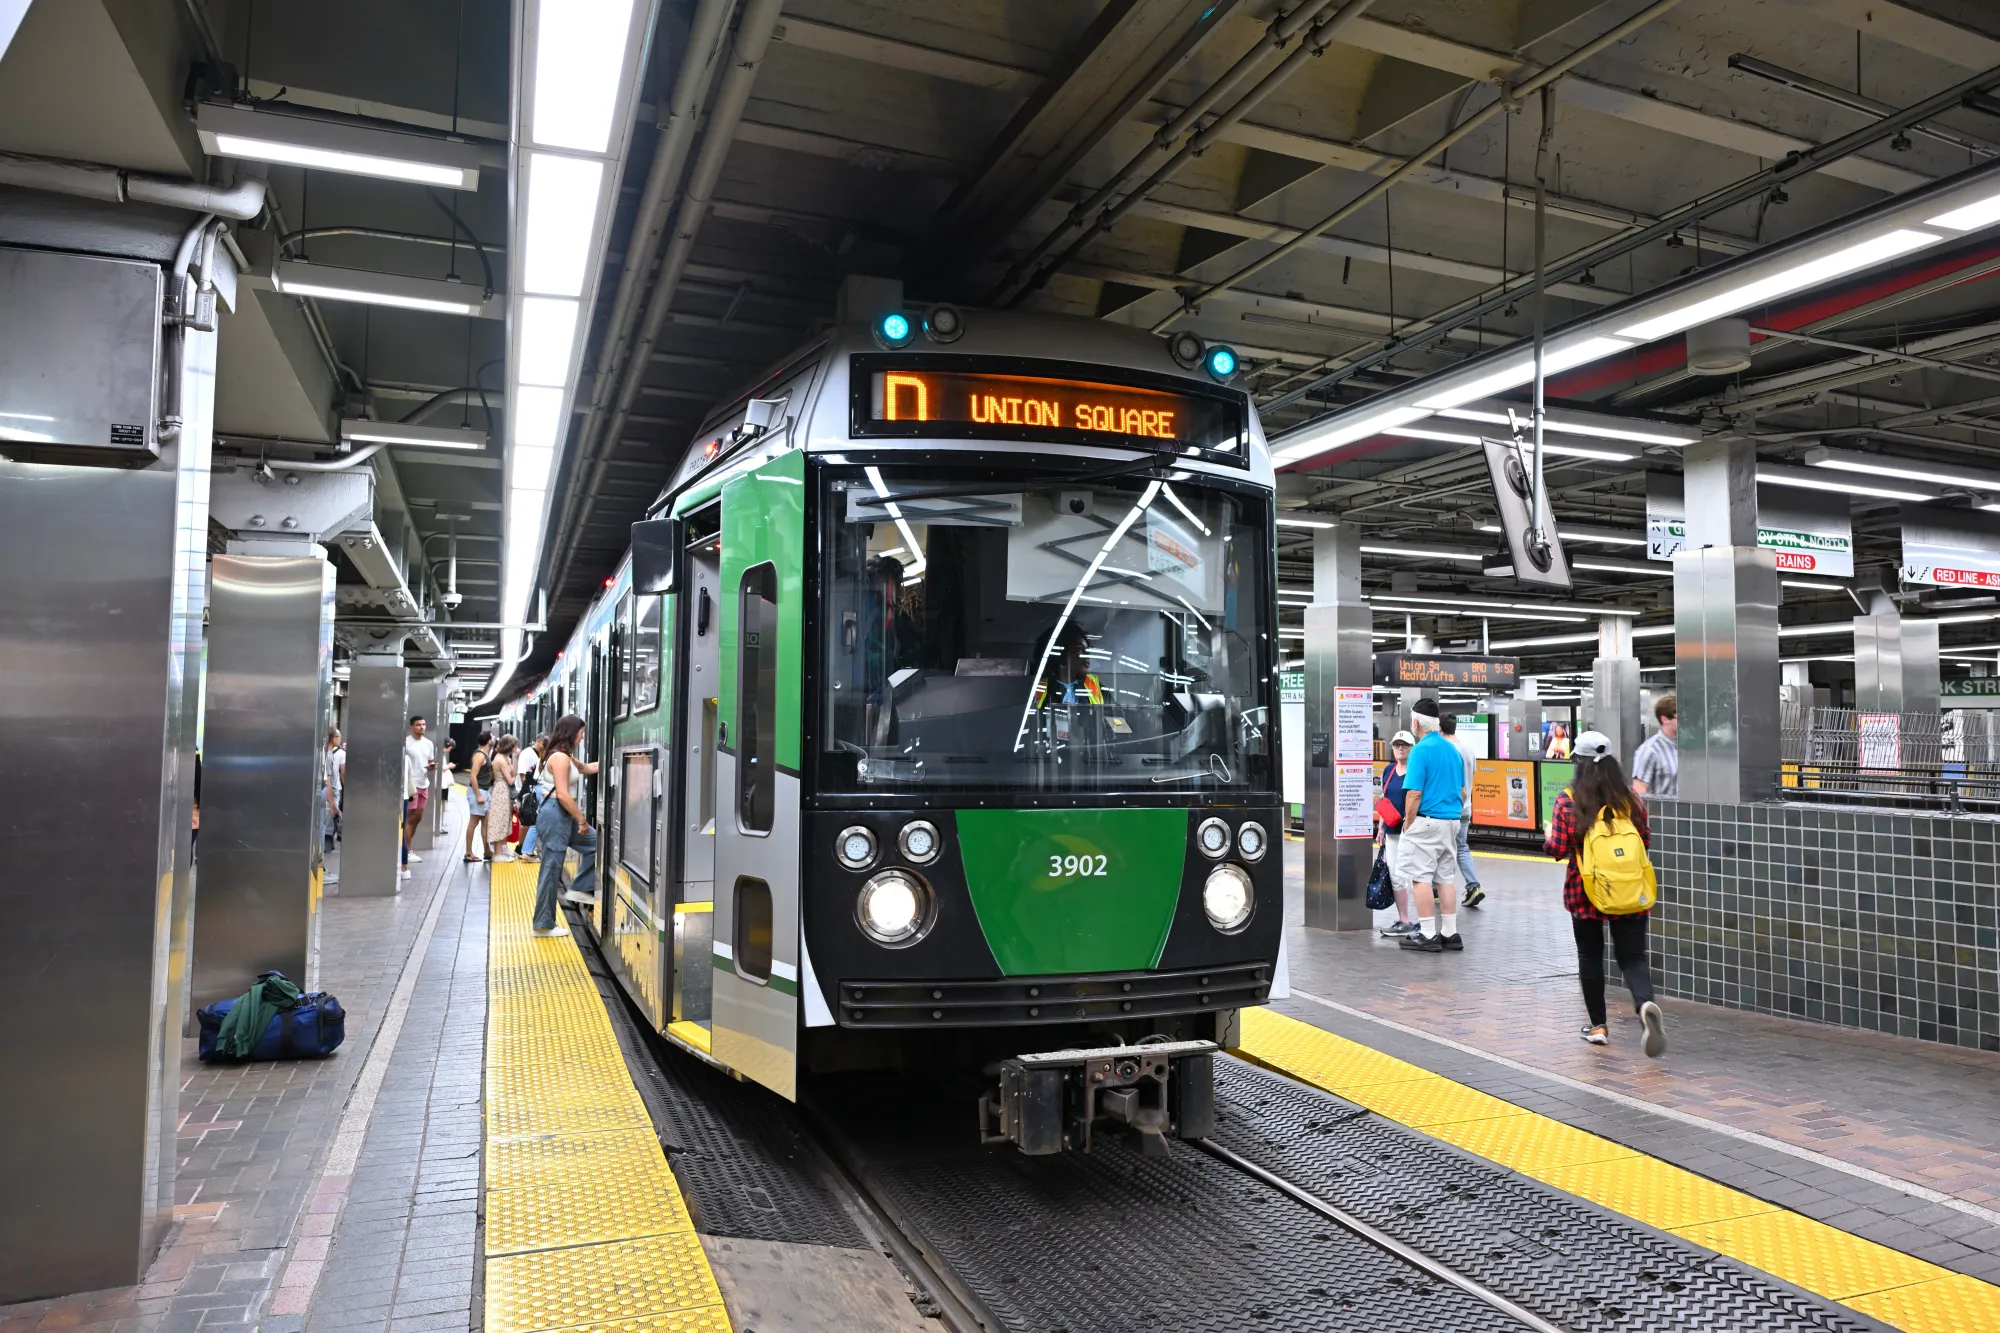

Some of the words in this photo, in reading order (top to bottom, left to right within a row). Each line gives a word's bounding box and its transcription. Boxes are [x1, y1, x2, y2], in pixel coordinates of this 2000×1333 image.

[971, 394, 1060, 428] UNION
[1075, 404, 1176, 439] SQUARE
[1775, 532, 1798, 547] CTR
[1809, 535, 1845, 549] NORTH
[1936, 569, 1956, 583] RED
[1957, 570, 1978, 584] LINE
[1400, 659, 1426, 671] Union
[1428, 660, 1440, 672] Sq
[1471, 662, 1487, 673] BRD
[1494, 663, 1515, 674] 5:52
[1400, 669, 1454, 682] Medfd/Tufts
[1462, 671, 1469, 682] 3
[1471, 673, 1487, 683] min
[1961, 679, 2000, 694] STR
[1281, 692, 1292, 700] CTR
[1048, 854, 1108, 877] 3902
